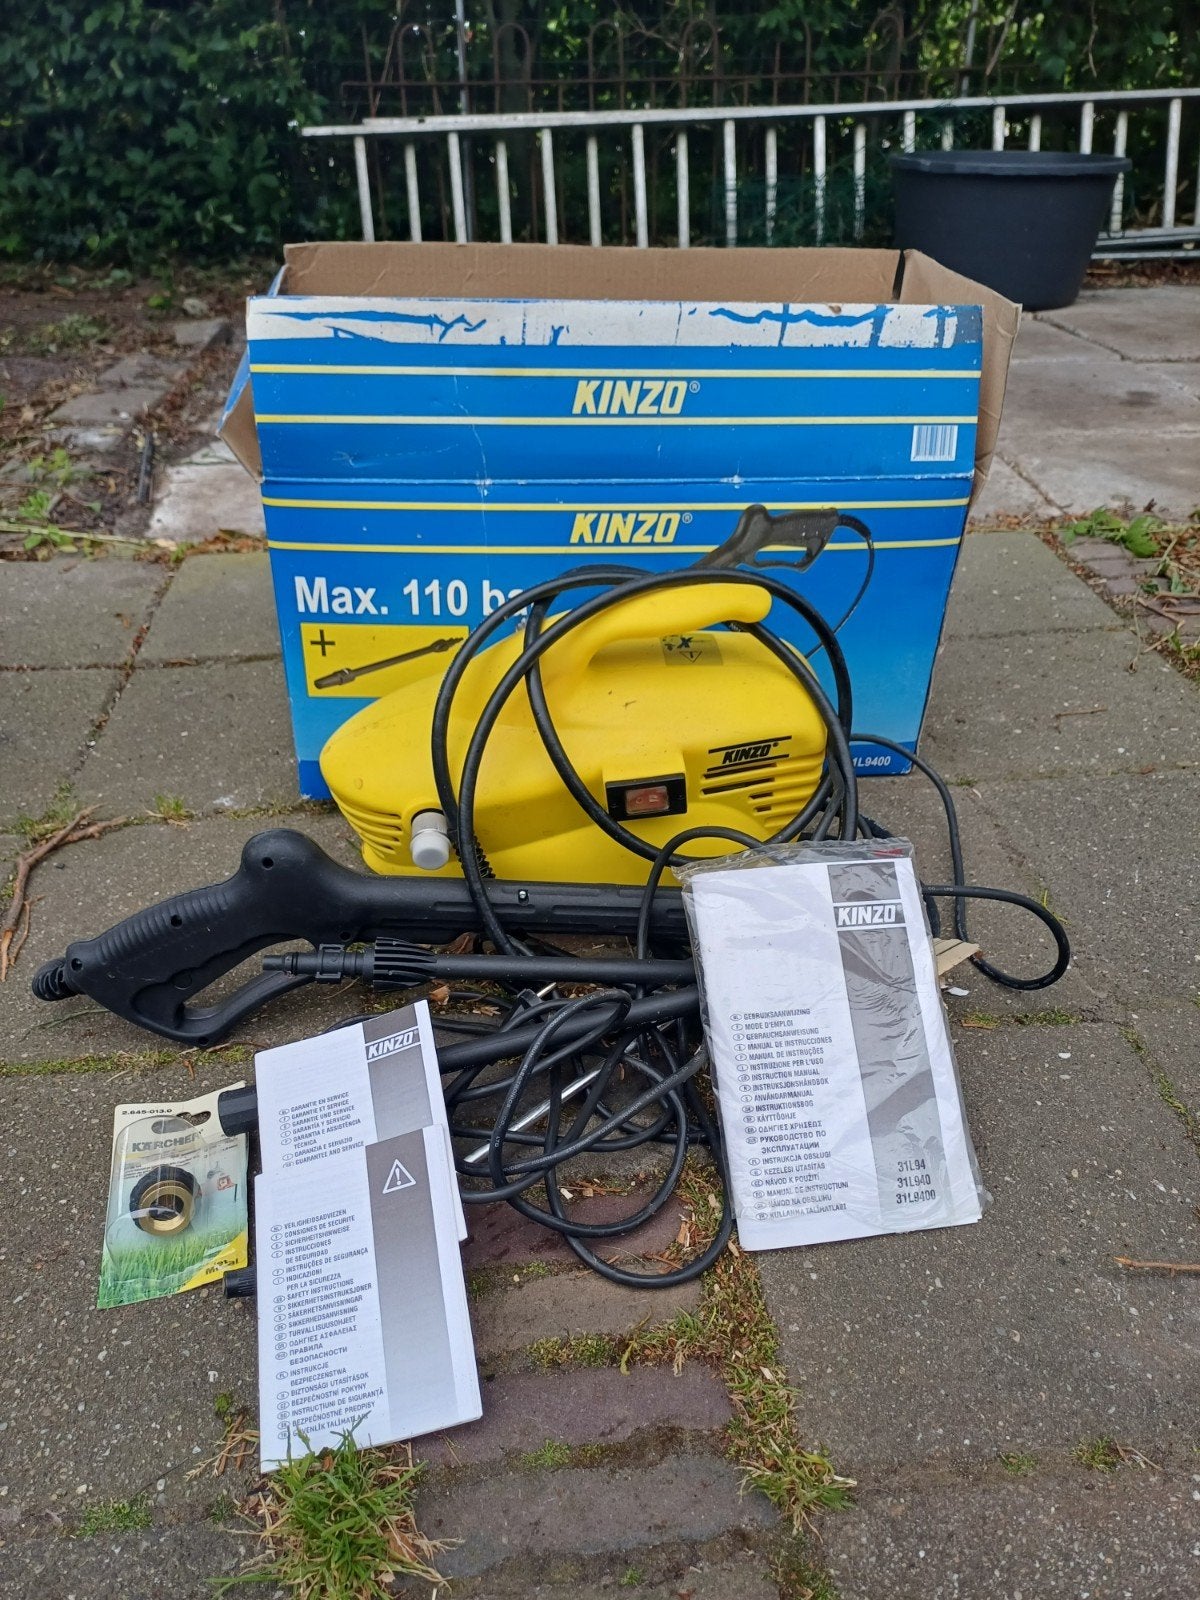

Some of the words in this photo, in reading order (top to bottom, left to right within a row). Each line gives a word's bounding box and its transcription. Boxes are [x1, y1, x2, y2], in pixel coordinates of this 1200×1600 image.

[294, 576, 388, 614] Max.
[403, 579, 468, 616] 110
[852, 756, 891, 767] 1L9400
[838, 904, 896, 926] KINZO
[765, 1020, 793, 1028] D'EMPLOI
[746, 1028, 819, 1040] GEBRAUCHSANWEISUNG
[368, 1032, 414, 1059] KINZO
[748, 1042, 773, 1050] MANUAL
[785, 1037, 832, 1046] INSTRUCCIONES
[750, 1061, 790, 1070] INSTRUZIONE
[752, 1071, 792, 1081] INSTRUCTION
[291, 1101, 317, 1112] GARANTIE
[327, 1092, 349, 1102] SERVICE
[756, 1100, 813, 1111] INSTRUKTIONSBOG
[292, 1108, 318, 1119] GARANTIE
[327, 1099, 349, 1110] SERVICE
[292, 1116, 318, 1127] GARANTIE
[333, 1105, 355, 1115] SERVICE
[326, 1114, 351, 1124] SERVICIO
[760, 1132, 813, 1143] РУКОВОДСТВО
[295, 1146, 322, 1157] GARANZIA
[328, 1137, 352, 1148] SERVIZIO
[296, 1153, 327, 1165] GUARANTEE
[342, 1141, 364, 1151] SERVICE
[762, 1142, 819, 1154] ЭКСПЛУАТАЦИИ
[762, 1154, 801, 1164] INSTRUKCJA
[898, 1159, 926, 1172] 31L94
[897, 1174, 931, 1188] 31L940
[767, 1187, 792, 1196] MANUAL
[896, 1190, 936, 1204] 31L9400
[285, 1225, 317, 1238] CONSIGNES
[285, 1239, 332, 1255] INSTRUCCIONES
[295, 1249, 328, 1262] SEGURIDAD
[286, 1269, 322, 1282] INDICAZIONI
[309, 1273, 341, 1286] SICUREZZA
[287, 1290, 309, 1300] SAFETY
[311, 1279, 354, 1295] INSTRUCTIONS
[287, 1283, 372, 1310] SIKKERHETSINSTRUKSJONER
[289, 1306, 358, 1328] SIKKERHEDSANVISNING
[290, 1343, 323, 1356] ПРАВИЛА
[290, 1346, 348, 1366] БЕЗОПАСНОСТИ
[290, 1362, 329, 1376] INSTRUKCJE
[341, 1383, 366, 1394] POKYNY
[345, 1401, 375, 1415] PREDPISY
